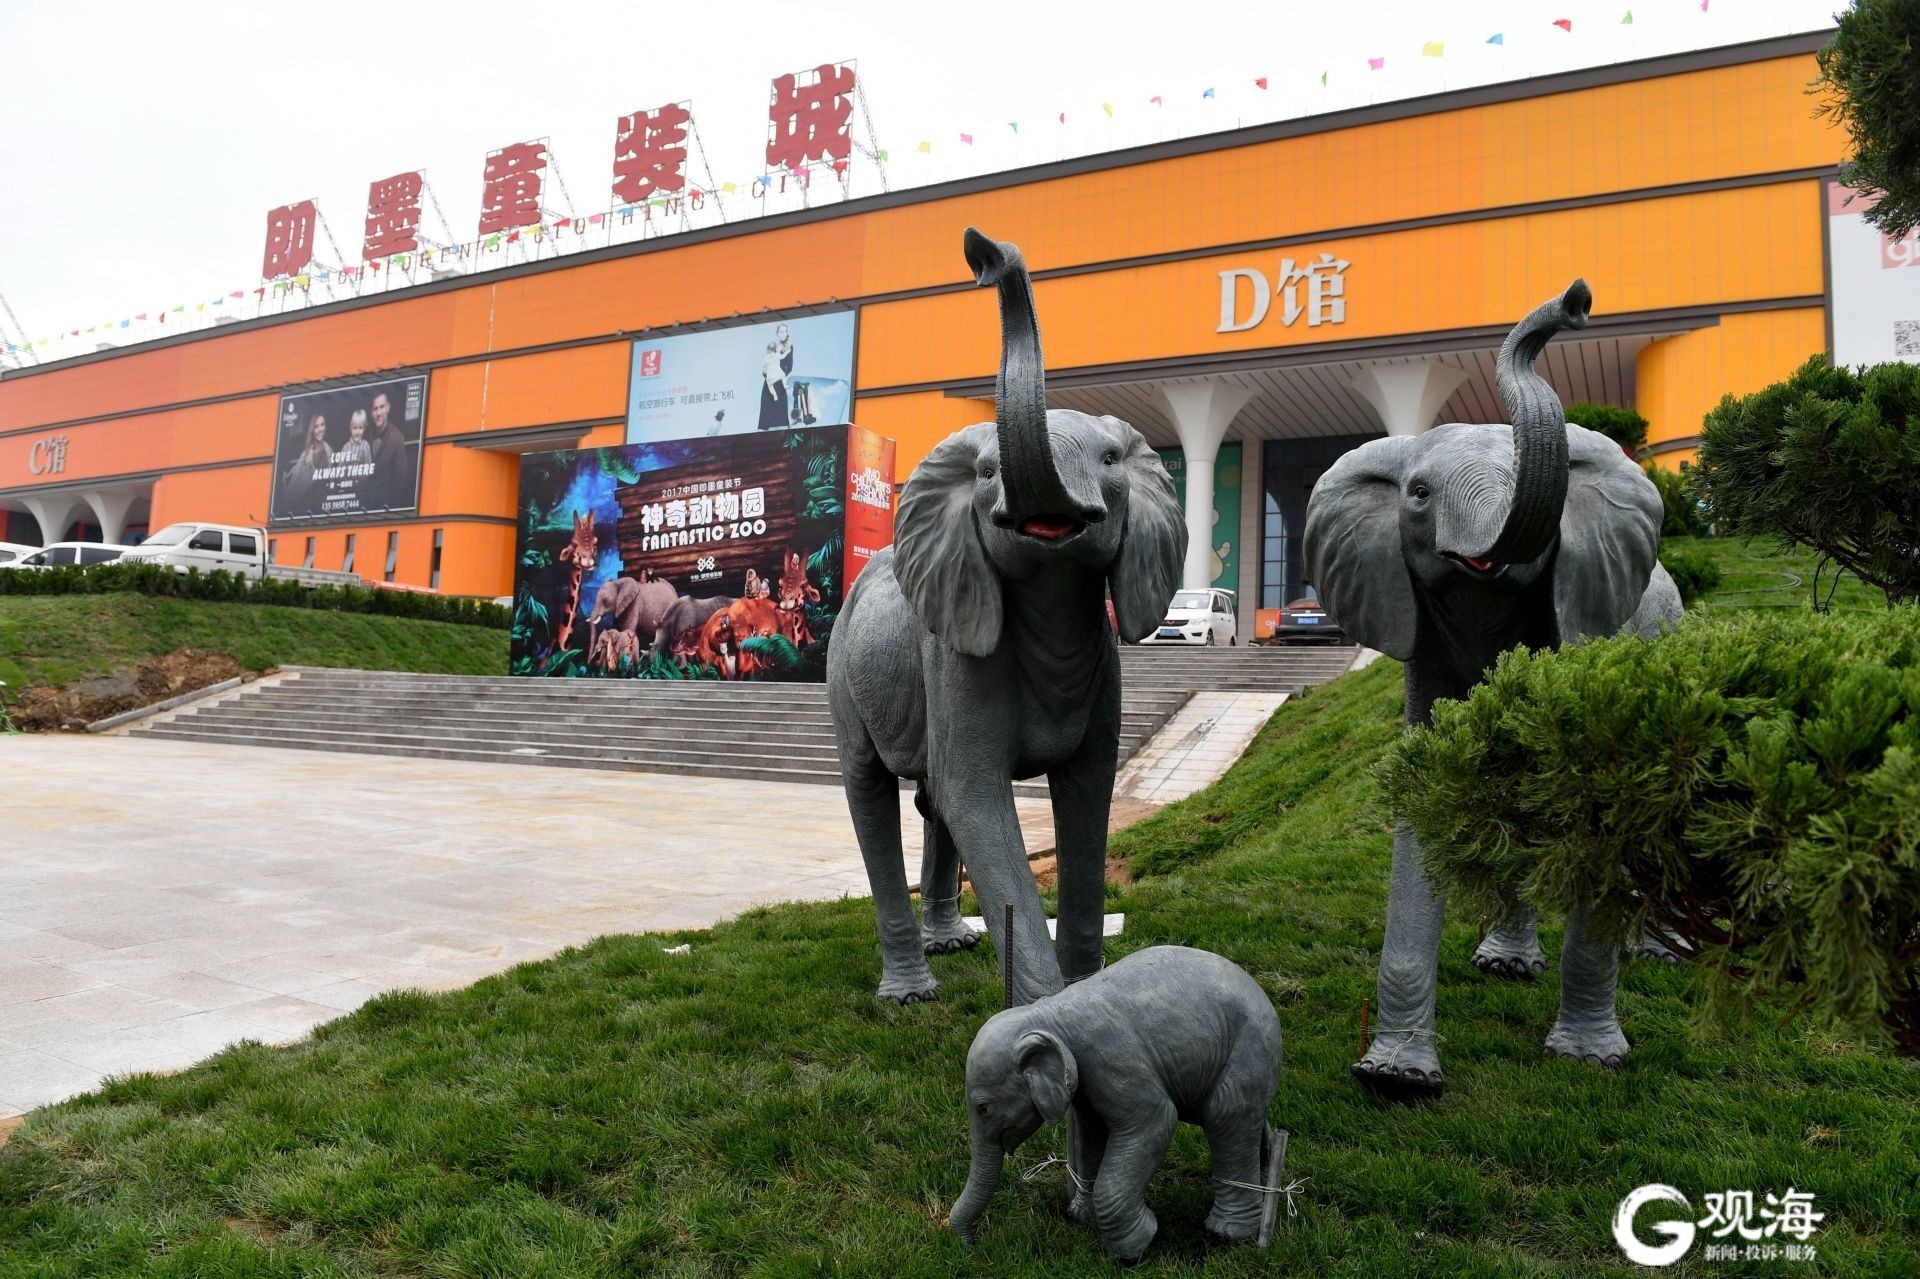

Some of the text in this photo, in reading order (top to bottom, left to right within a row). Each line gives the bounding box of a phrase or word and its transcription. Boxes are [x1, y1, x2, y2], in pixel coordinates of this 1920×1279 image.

[262, 62, 857, 281] 即墨童装城
[1216, 253, 1352, 333] D馆
[28, 435, 70, 475] C馆
[312, 463, 375, 481] ALWAYS THERE
[330, 451, 352, 464] LOVE
[641, 487, 765, 534] 神奇动物园
[642, 519, 767, 551] FANTASTIC ZOO
